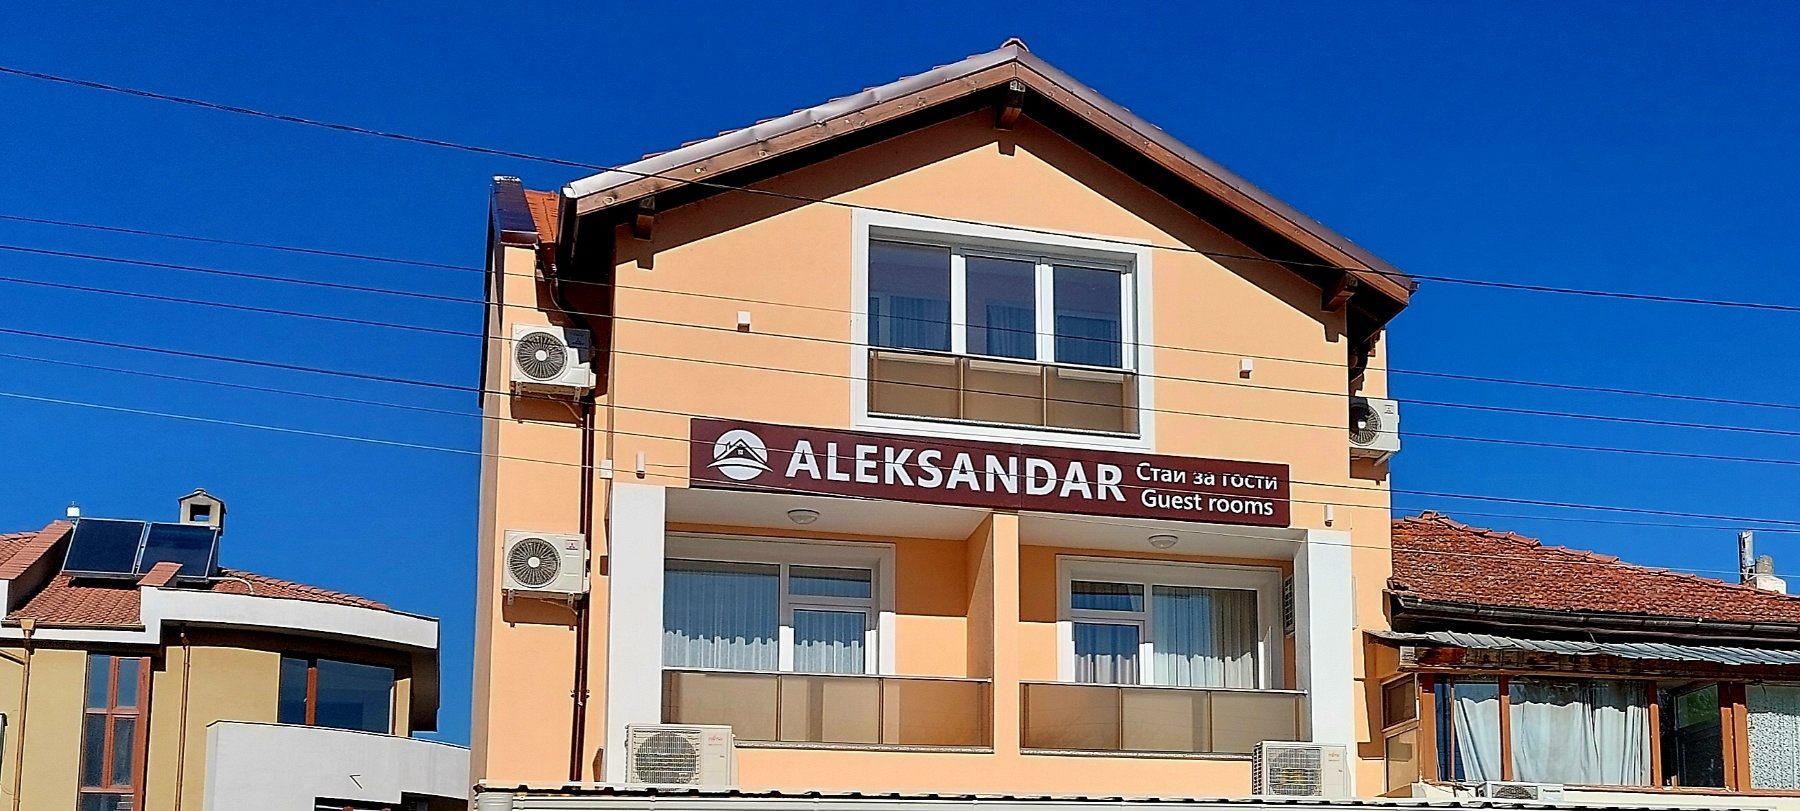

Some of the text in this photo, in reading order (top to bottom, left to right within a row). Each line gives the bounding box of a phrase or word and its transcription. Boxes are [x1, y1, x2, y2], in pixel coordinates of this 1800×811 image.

[785, 439, 1126, 502] ALEKSANDAR
[1136, 462, 1278, 491] Стаи за гости
[1141, 489, 1274, 516] Guest rooms
